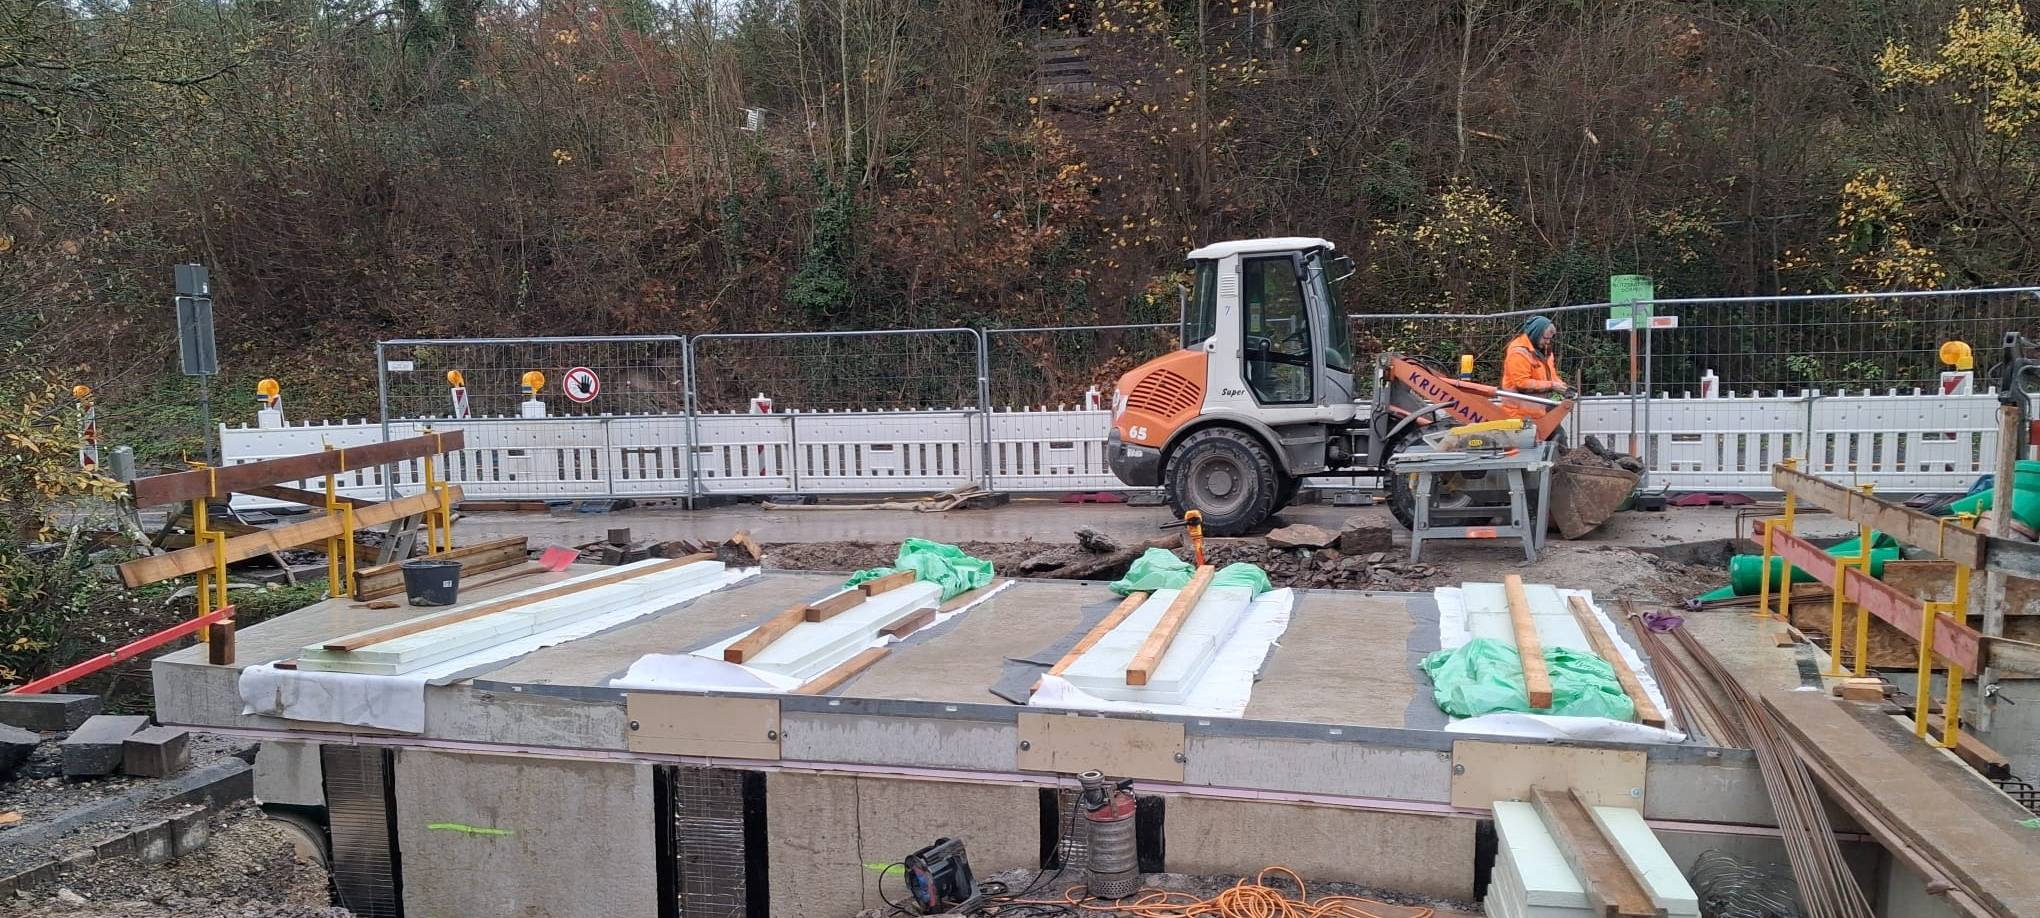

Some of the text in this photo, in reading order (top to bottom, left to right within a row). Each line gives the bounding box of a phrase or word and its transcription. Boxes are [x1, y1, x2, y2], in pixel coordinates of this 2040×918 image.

[1222, 388, 1245, 398] Super
[1409, 372, 1488, 423] KRUTMAN
[1129, 425, 1147, 440] 65
